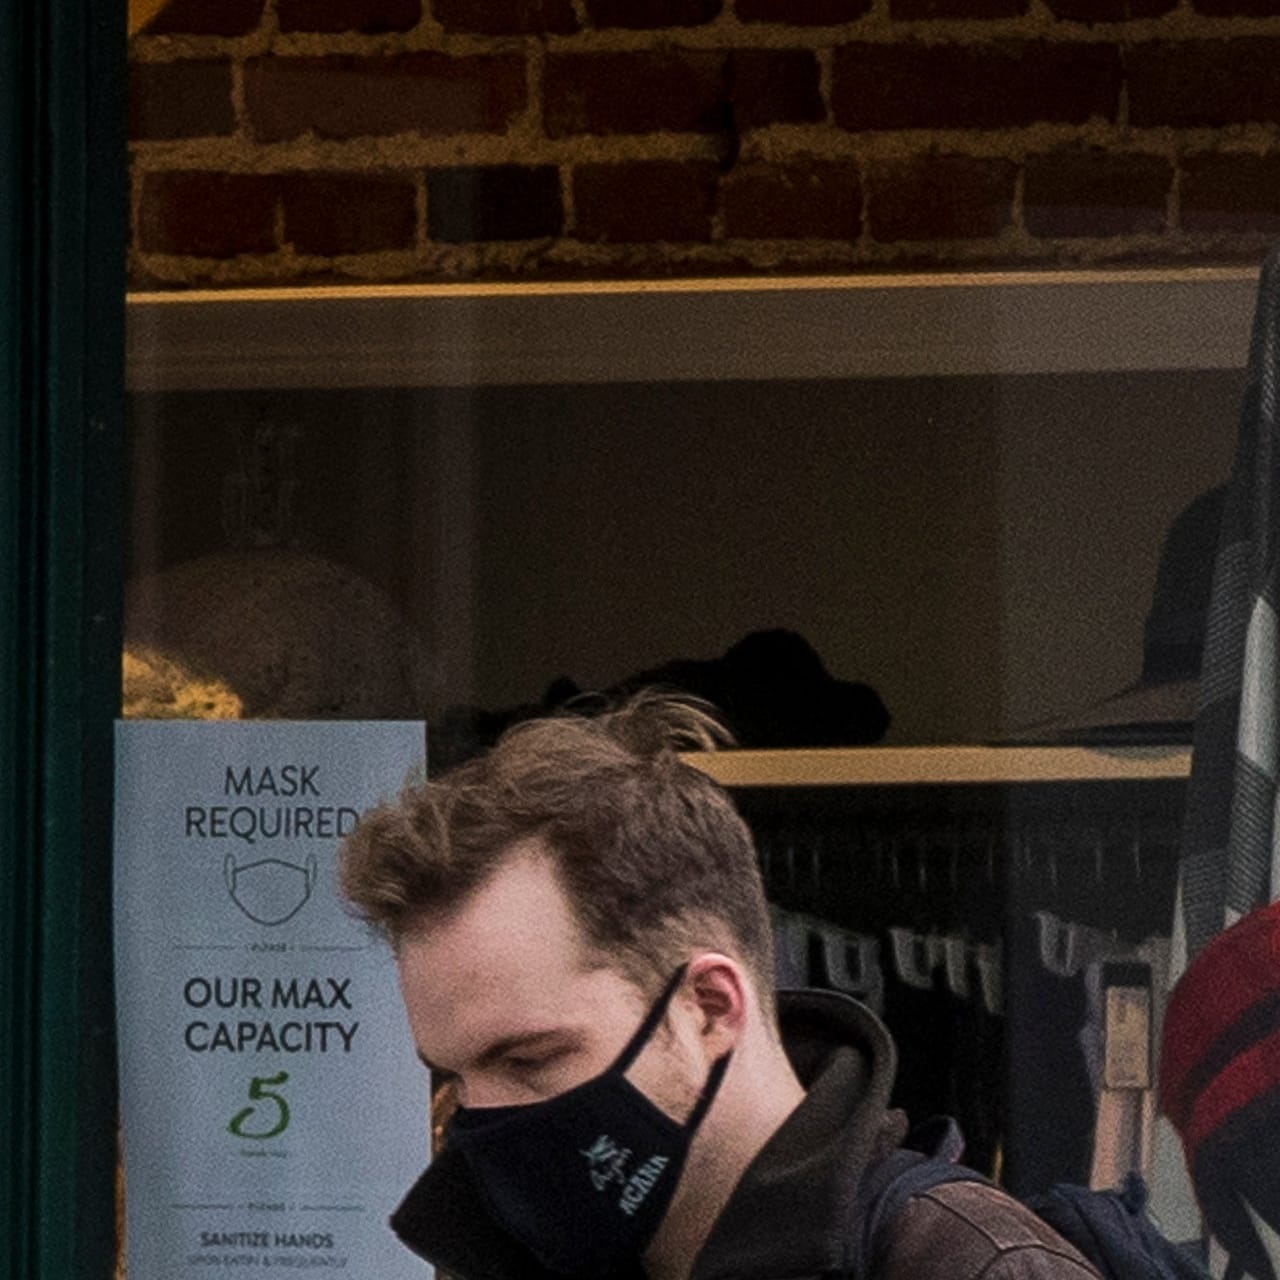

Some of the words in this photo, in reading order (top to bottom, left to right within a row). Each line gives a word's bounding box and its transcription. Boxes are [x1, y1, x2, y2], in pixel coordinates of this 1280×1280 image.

[224, 765, 321, 797] MASK
[185, 806, 360, 844] REQUIRED
[184, 977, 262, 1009] OUR
[272, 977, 353, 1010] MAX
[184, 1021, 360, 1053] CAPACITY
[226, 1070, 290, 1140] 5
[201, 1232, 269, 1248] SANITIZE
[275, 1233, 334, 1249] HANDS
